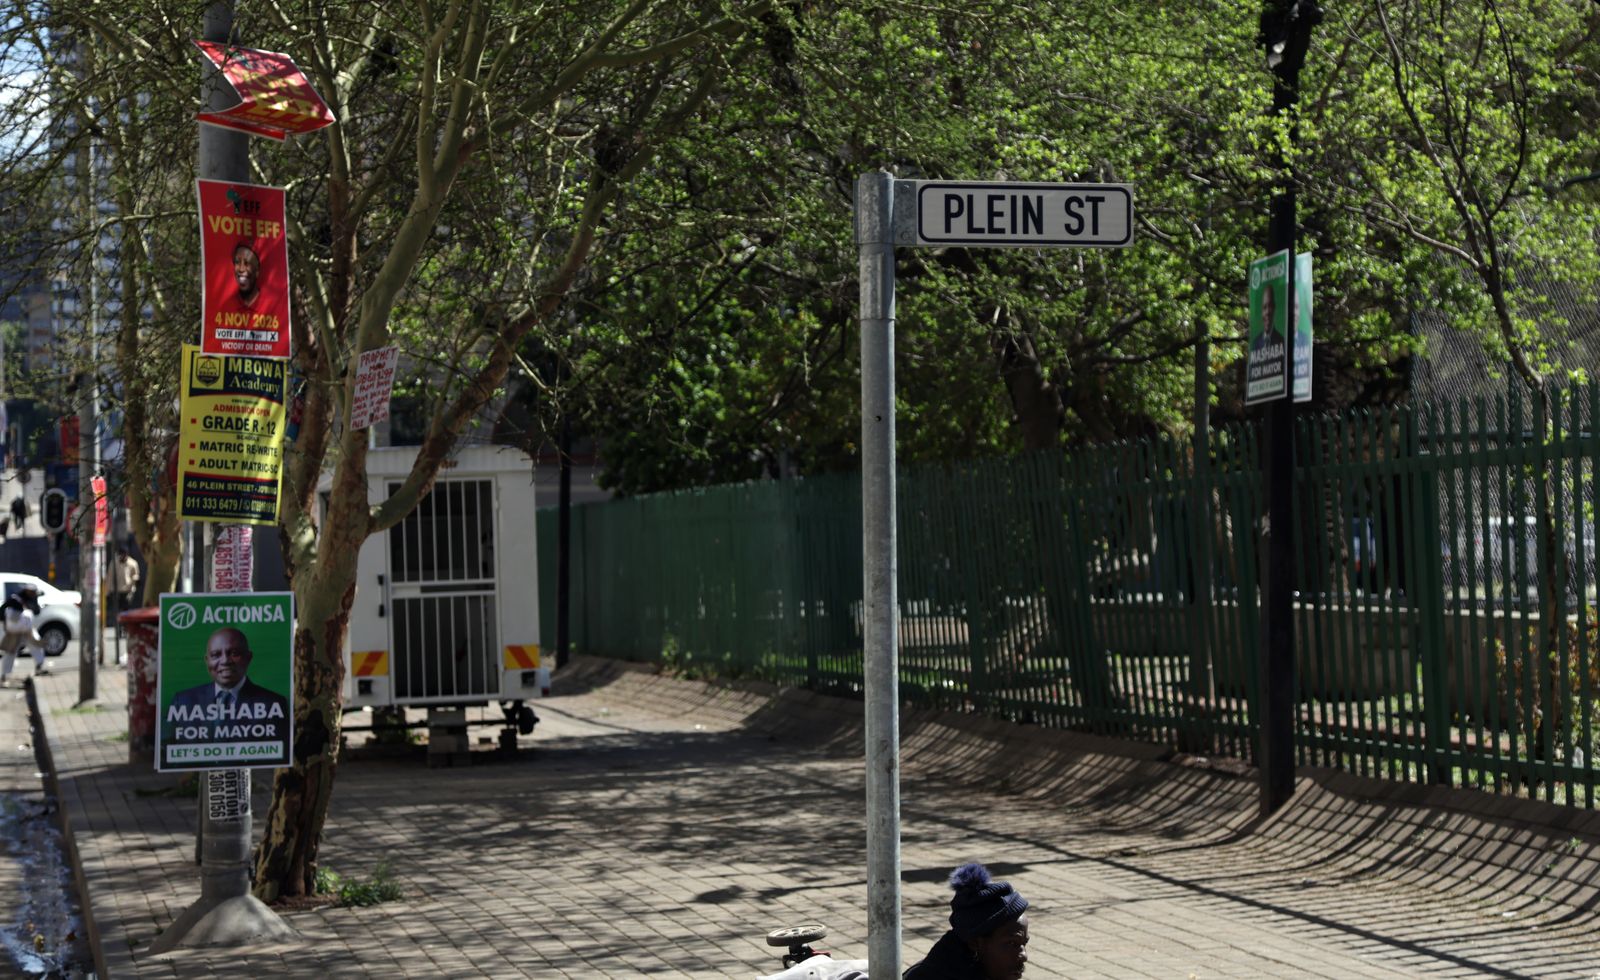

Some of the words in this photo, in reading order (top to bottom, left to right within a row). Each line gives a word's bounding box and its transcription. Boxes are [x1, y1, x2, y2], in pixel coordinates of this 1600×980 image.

[244, 200, 261, 213] EFF
[944, 194, 1043, 235] PLEIN
[1064, 195, 1105, 236] ST
[208, 215, 252, 235] VOTE
[256, 220, 280, 239] EFF
[215, 312, 222, 324] 4
[225, 312, 250, 327] NOV
[253, 314, 279, 330] 2026
[217, 330, 232, 338] VOTE
[222, 341, 245, 351] VICTORY
[254, 343, 272, 352] DEATH
[1250, 342, 1284, 365] MASHABA
[228, 357, 282, 379] MBOWA
[229, 375, 280, 397] Academy
[203, 415, 250, 432] GRADE
[252, 418, 259, 433] R
[266, 421, 276, 435] 12
[199, 440, 244, 454] MATRIC
[199, 457, 238, 471] ADULT
[186, 480, 198, 489] 46
[200, 481, 225, 491] PLEIN
[185, 496, 200, 508] 011
[202, 497, 217, 510] 333
[219, 498, 238, 511] 6479
[201, 603, 285, 624] ACTIONSA
[166, 702, 284, 722] MASHABA
[175, 726, 208, 740] FOR
[214, 724, 276, 739] MAYOR
[170, 747, 199, 758] LET'S
[203, 747, 222, 757] DO
[226, 746, 236, 756] IT
[239, 744, 279, 756] AGAIN
[209, 774, 225, 793] 306
[225, 769, 239, 817] ORTION
[210, 795, 226, 818] 0156
